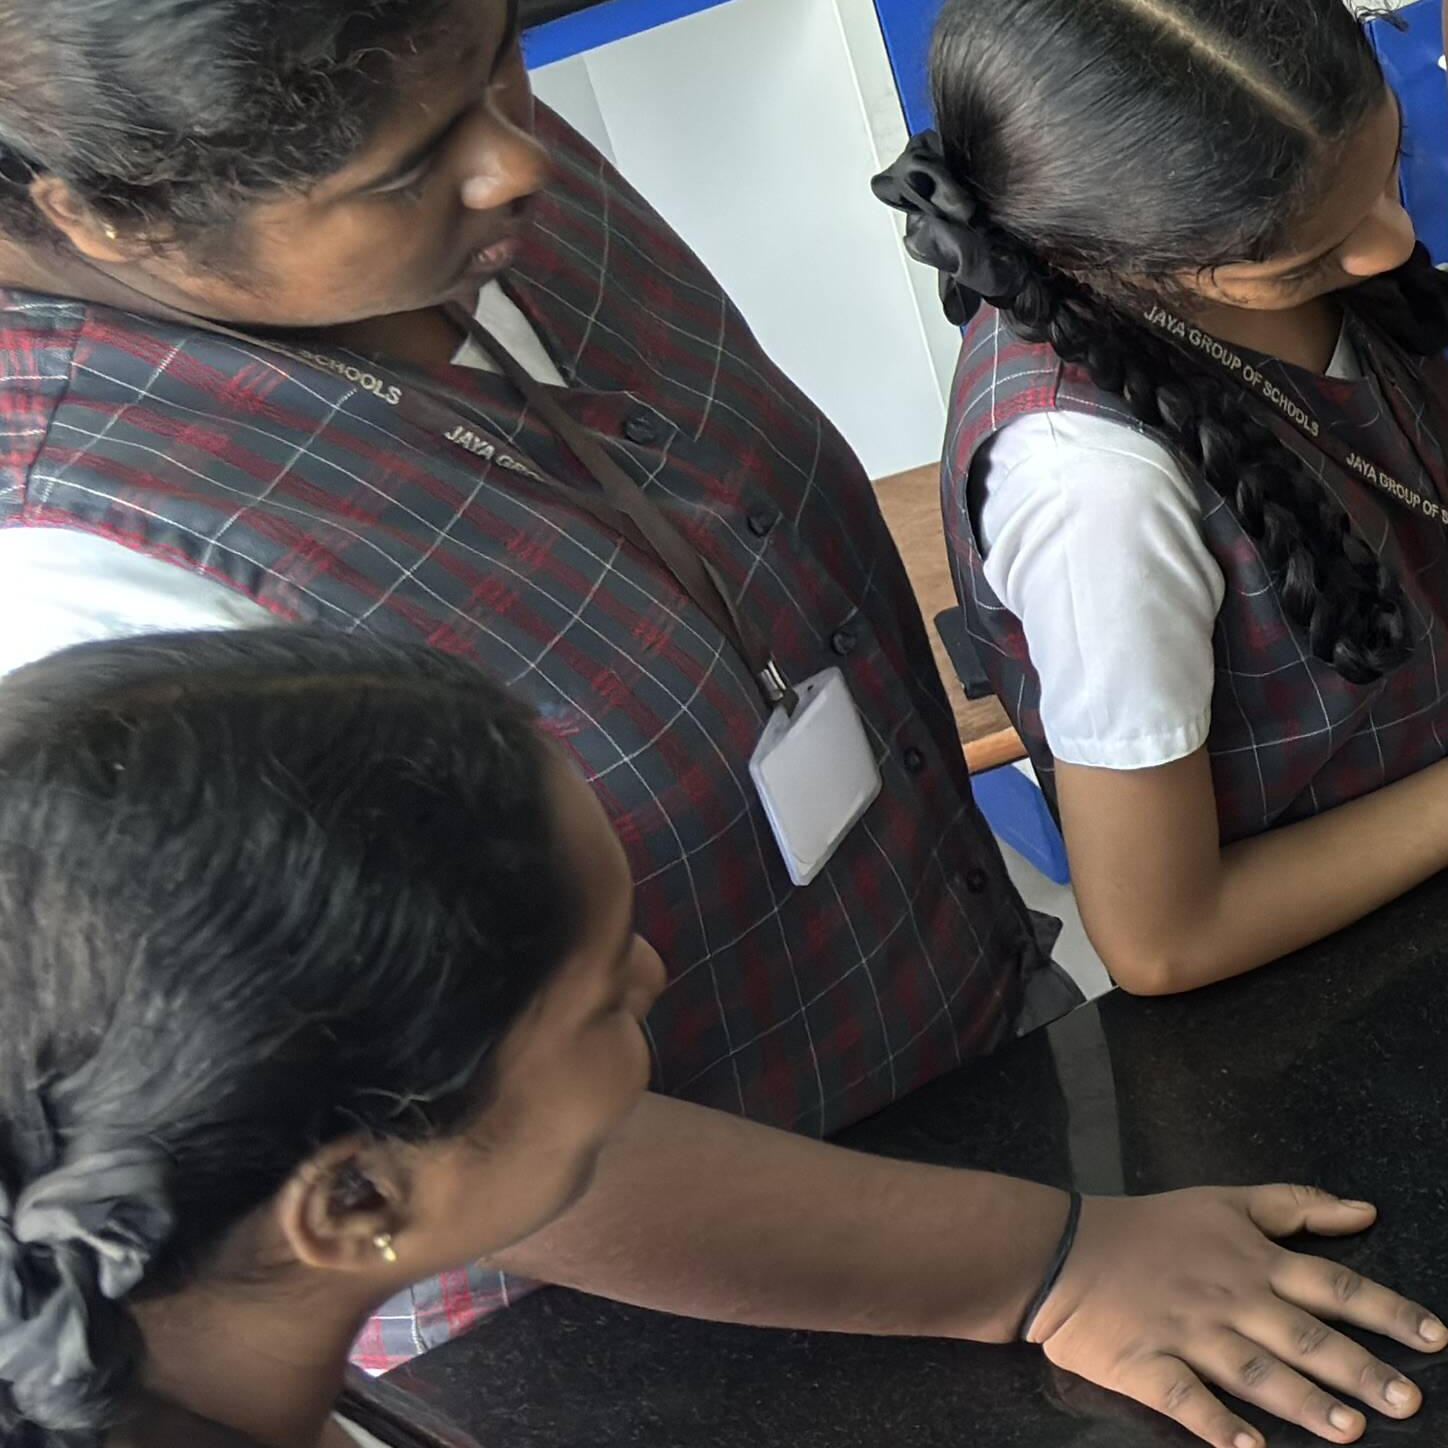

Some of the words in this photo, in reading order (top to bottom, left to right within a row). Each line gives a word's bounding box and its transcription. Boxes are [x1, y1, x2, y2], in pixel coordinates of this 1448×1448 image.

[1143, 305, 1186, 339] JAYA
[1188, 328, 1242, 372] GROUP
[1242, 363, 1265, 388] OF
[1261, 380, 1321, 438] SCHOOLS
[443, 424, 495, 462] JAYA
[1345, 452, 1378, 485] JAYA
[1378, 472, 1421, 510] GROUP
[1421, 500, 1441, 521] OF
